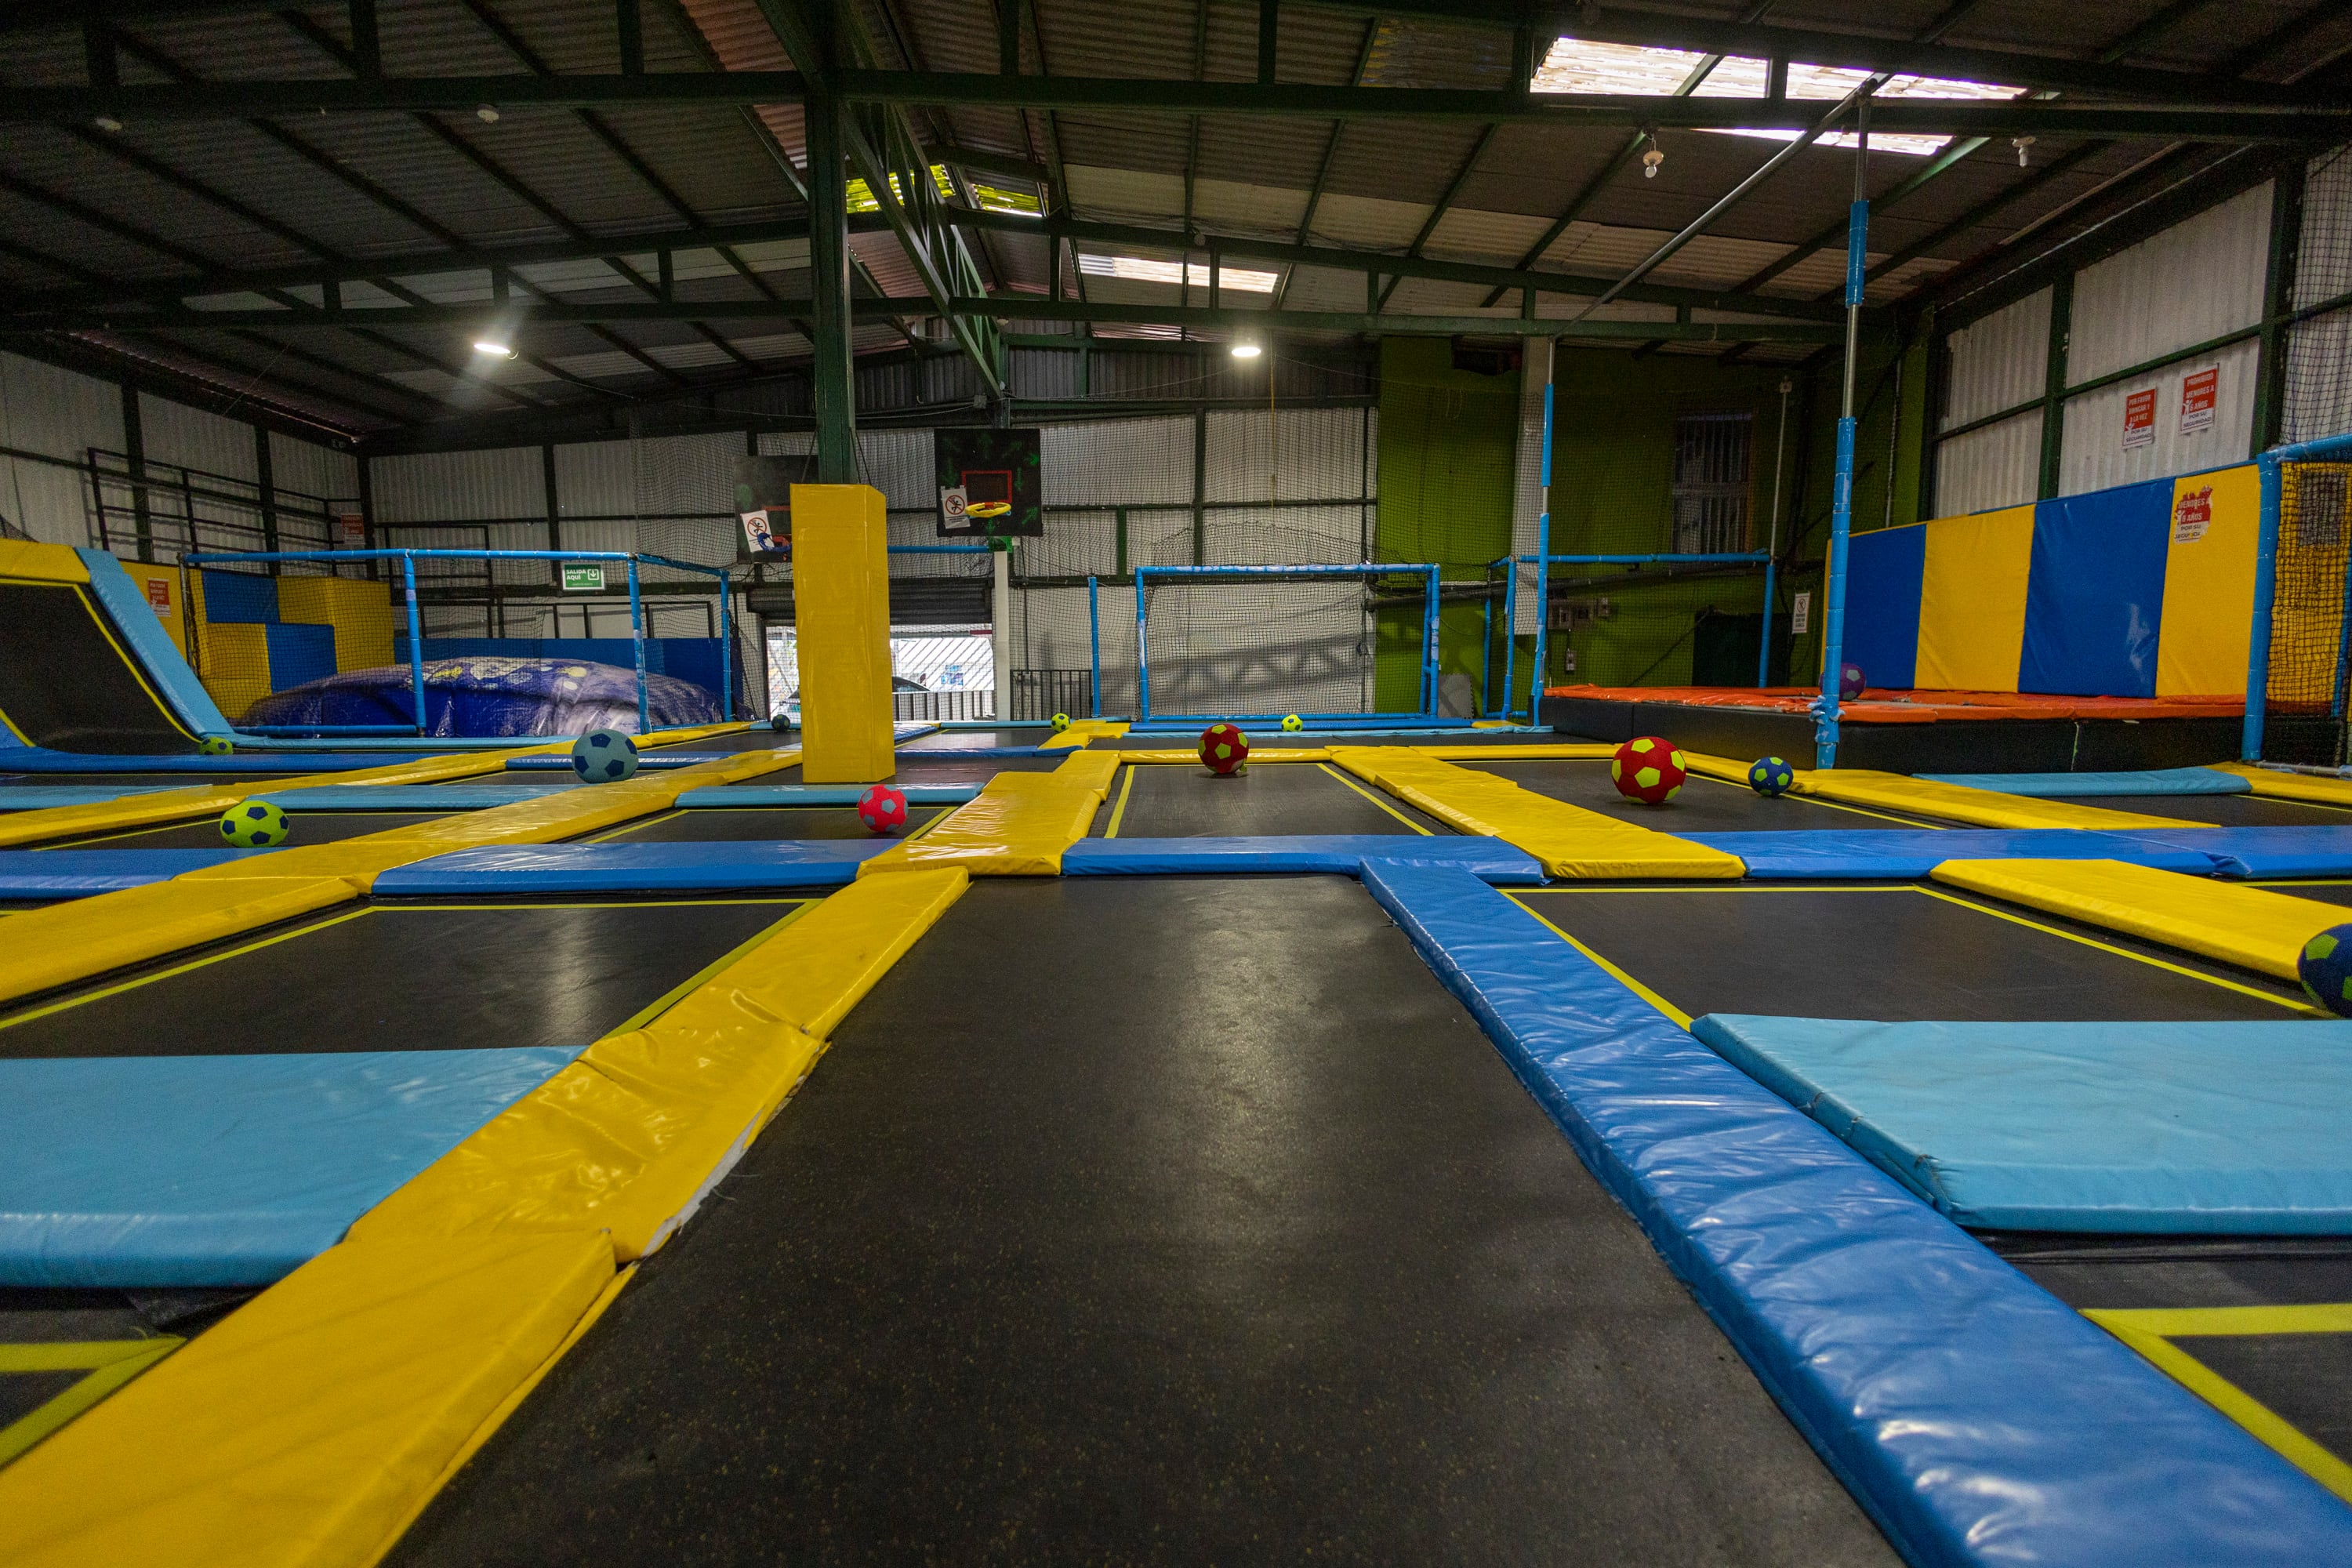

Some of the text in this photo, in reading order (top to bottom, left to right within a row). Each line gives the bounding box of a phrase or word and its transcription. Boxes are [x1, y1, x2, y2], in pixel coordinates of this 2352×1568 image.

[2186, 385, 2209, 399] MENORES
[2194, 399, 2209, 410] AÑOS
[2183, 416, 2212, 427] SEGURIDAD
[2125, 433, 2151, 442] SEGURIDAD
[2187, 512, 2202, 521] AÑOS
